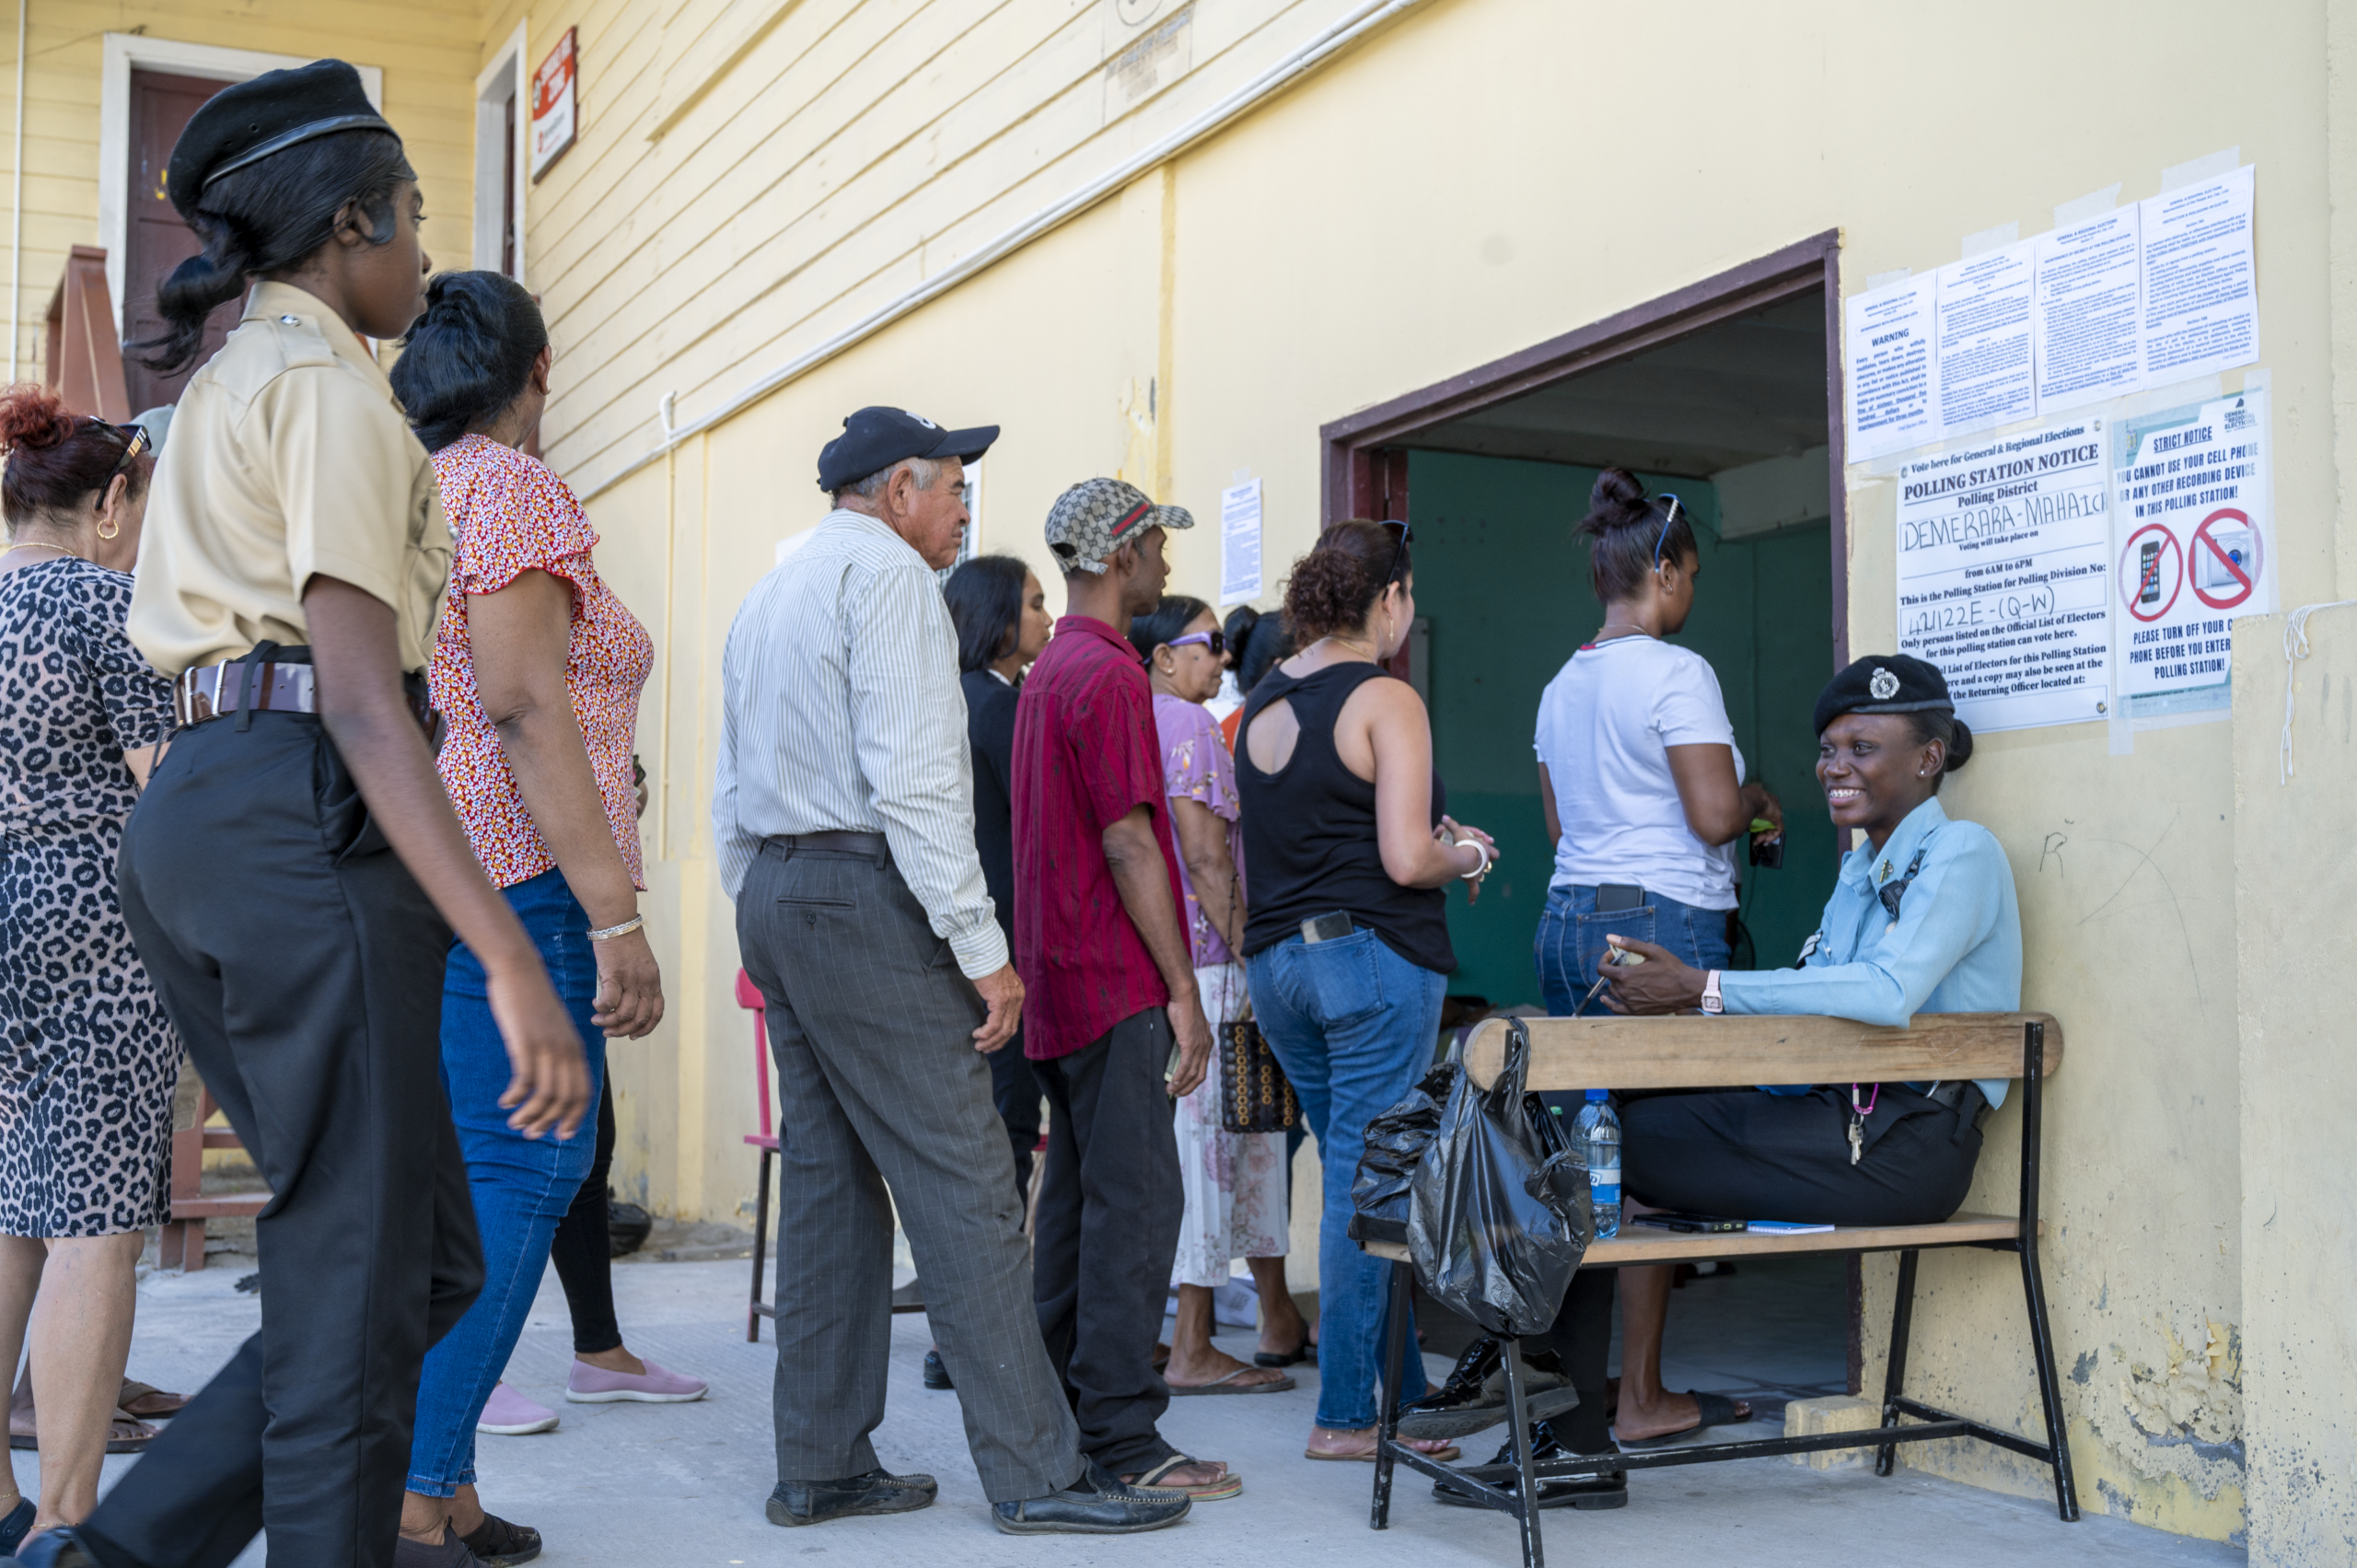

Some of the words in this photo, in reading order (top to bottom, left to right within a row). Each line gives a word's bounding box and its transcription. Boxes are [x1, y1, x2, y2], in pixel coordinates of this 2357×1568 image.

[1871, 328, 1909, 347] WARNING
[2224, 409, 2248, 418] GENERAL
[2224, 417, 2256, 429] ELECTIONS
[2228, 412, 2255, 423] REGIONAL
[1910, 462, 1929, 473] Vote
[1930, 459, 1949, 469] here
[1950, 454, 1962, 465] for
[1963, 445, 1996, 461] General
[2005, 434, 2043, 452] Regional
[2044, 426, 2084, 443] Elections
[2154, 433, 2181, 452] STRICT
[2183, 425, 2212, 446] NOTICE
[1904, 473, 1966, 500] POLLING
[1969, 458, 2034, 486] STATION
[2038, 443, 2098, 470] NOTICE
[2117, 469, 2131, 484] YOU
[2133, 462, 2165, 481] CANNOT
[2167, 459, 2180, 473] USE
[2183, 453, 2204, 470] YOUR
[2207, 448, 2226, 464] CELL
[2230, 442, 2258, 459] PHONE
[1957, 491, 1994, 508] Polling
[1997, 480, 2038, 499] District
[2119, 488, 2129, 502] OR
[2132, 484, 2149, 500] ANY
[2151, 479, 2174, 496] OTHER
[2176, 469, 2221, 490] RECORDING
[2224, 462, 2255, 481] DEVICE
[2135, 505, 2144, 517] IN
[2147, 500, 2162, 516] THIS
[2165, 493, 2197, 511] POLLING
[2200, 484, 2237, 505] STATION!
[1958, 541, 1980, 551] Voting
[1980, 537, 1992, 547] will
[1993, 535, 2009, 544] take
[2010, 532, 2028, 543] place
[2029, 529, 2038, 538] on
[1965, 569, 1984, 578] from
[1985, 563, 2003, 575] 6AM
[2004, 563, 2014, 571] to
[2014, 558, 2032, 569] 6PM
[1899, 595, 1919, 606] This
[1921, 593, 1928, 603] is
[1929, 591, 1942, 601] the
[1944, 587, 1972, 598] Polling
[1973, 581, 2003, 594] Station
[2003, 577, 2016, 588] for
[2018, 573, 2049, 586] Polling
[2049, 565, 2087, 580] Division
[2089, 563, 2106, 574] No:
[1900, 637, 1921, 649] Only
[1922, 634, 1954, 648] persons
[1955, 628, 1978, 641] listed
[1980, 629, 1990, 637] on
[1991, 625, 2005, 635] the
[2006, 619, 2037, 633] Official
[2038, 617, 2054, 628] List
[2055, 613, 2065, 625] of
[2066, 610, 2106, 623] Electors
[2133, 628, 2159, 645] PLEASE
[2162, 625, 2183, 640] TURN
[2186, 622, 2200, 637] OFF
[2201, 619, 2223, 634] YOUR
[1925, 648, 1937, 658] for
[1939, 645, 1955, 656] this
[1956, 642, 1985, 656] polling
[1986, 637, 2015, 649] station
[2017, 636, 2032, 645] can
[2034, 632, 2052, 642] vote
[2053, 630, 2077, 639] here.
[2130, 648, 2153, 664] PHONE
[2155, 644, 2185, 660] BEFORE
[2188, 641, 2202, 656] YOU
[2205, 638, 2231, 654] ENTER
[1947, 663, 1962, 674] List
[1964, 661, 1973, 671] of
[1974, 658, 2008, 670] Electors
[2009, 656, 2022, 666] for
[2023, 652, 2039, 663] this
[2040, 648, 2072, 661] Polling
[2073, 644, 2107, 656] Station
[1960, 674, 1976, 685] and
[1983, 673, 2003, 683] copy
[2005, 670, 2022, 680] may
[2024, 667, 2041, 677] also
[2043, 665, 2053, 675] be
[2054, 663, 2074, 673] seen
[2076, 660, 2085, 670] at
[2087, 658, 2103, 668] the
[2154, 663, 2188, 679] POLLING
[2189, 657, 2224, 675] STATION!
[1953, 690, 1967, 700] the
[1968, 684, 2009, 698] Returning
[2010, 681, 2039, 692] Officer
[2040, 675, 2072, 689] located
[2073, 675, 2084, 684] at:
